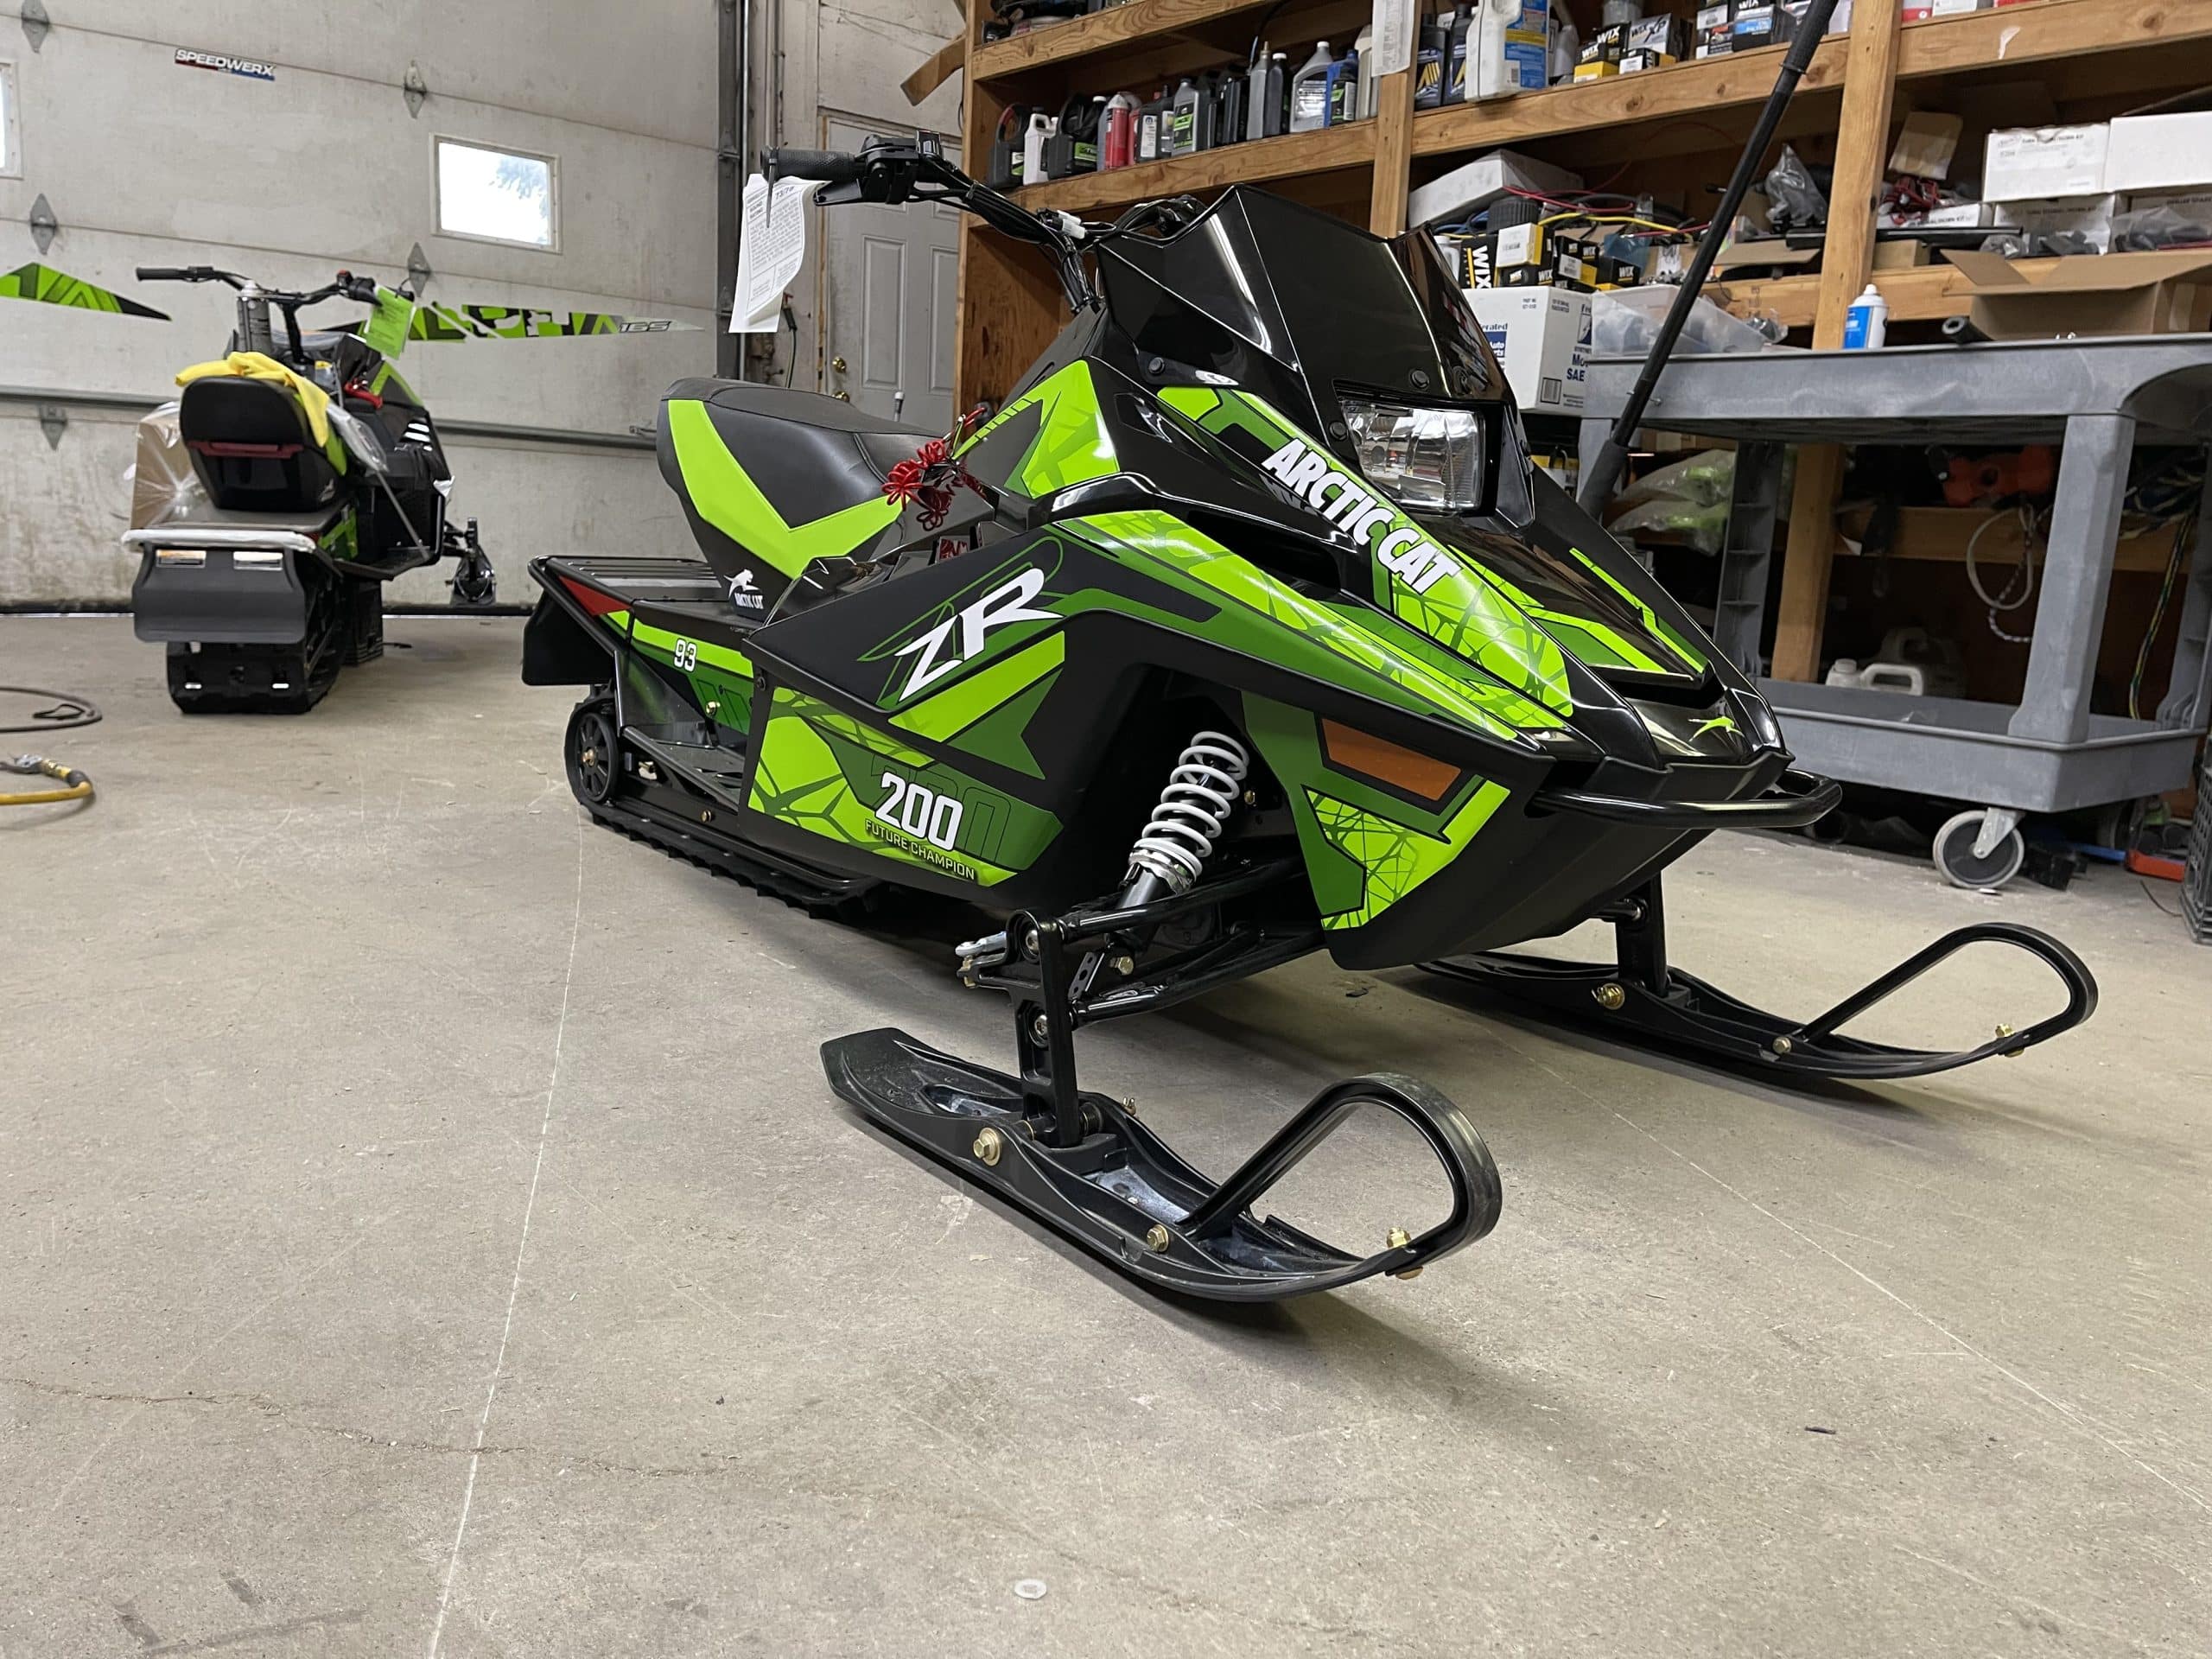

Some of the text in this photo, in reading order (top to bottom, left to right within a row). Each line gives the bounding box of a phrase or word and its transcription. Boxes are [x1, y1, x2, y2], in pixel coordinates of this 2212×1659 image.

[1597, 26, 1621, 43] WIX
[175, 49, 275, 76] SPEEDWERX
[1582, 44, 1599, 59] WIX
[1472, 245, 1492, 288] WIX
[1619, 266, 1633, 277] WIX
[1572, 353, 1588, 367] Mo
[1567, 368, 1586, 382] SAE
[1261, 438, 1463, 594] ARCTIC CAT
[893, 568, 1064, 702] ZR
[674, 639, 697, 671] 93
[875, 771, 963, 851] 200
[865, 820, 975, 880] FUTURE CHAMPION
